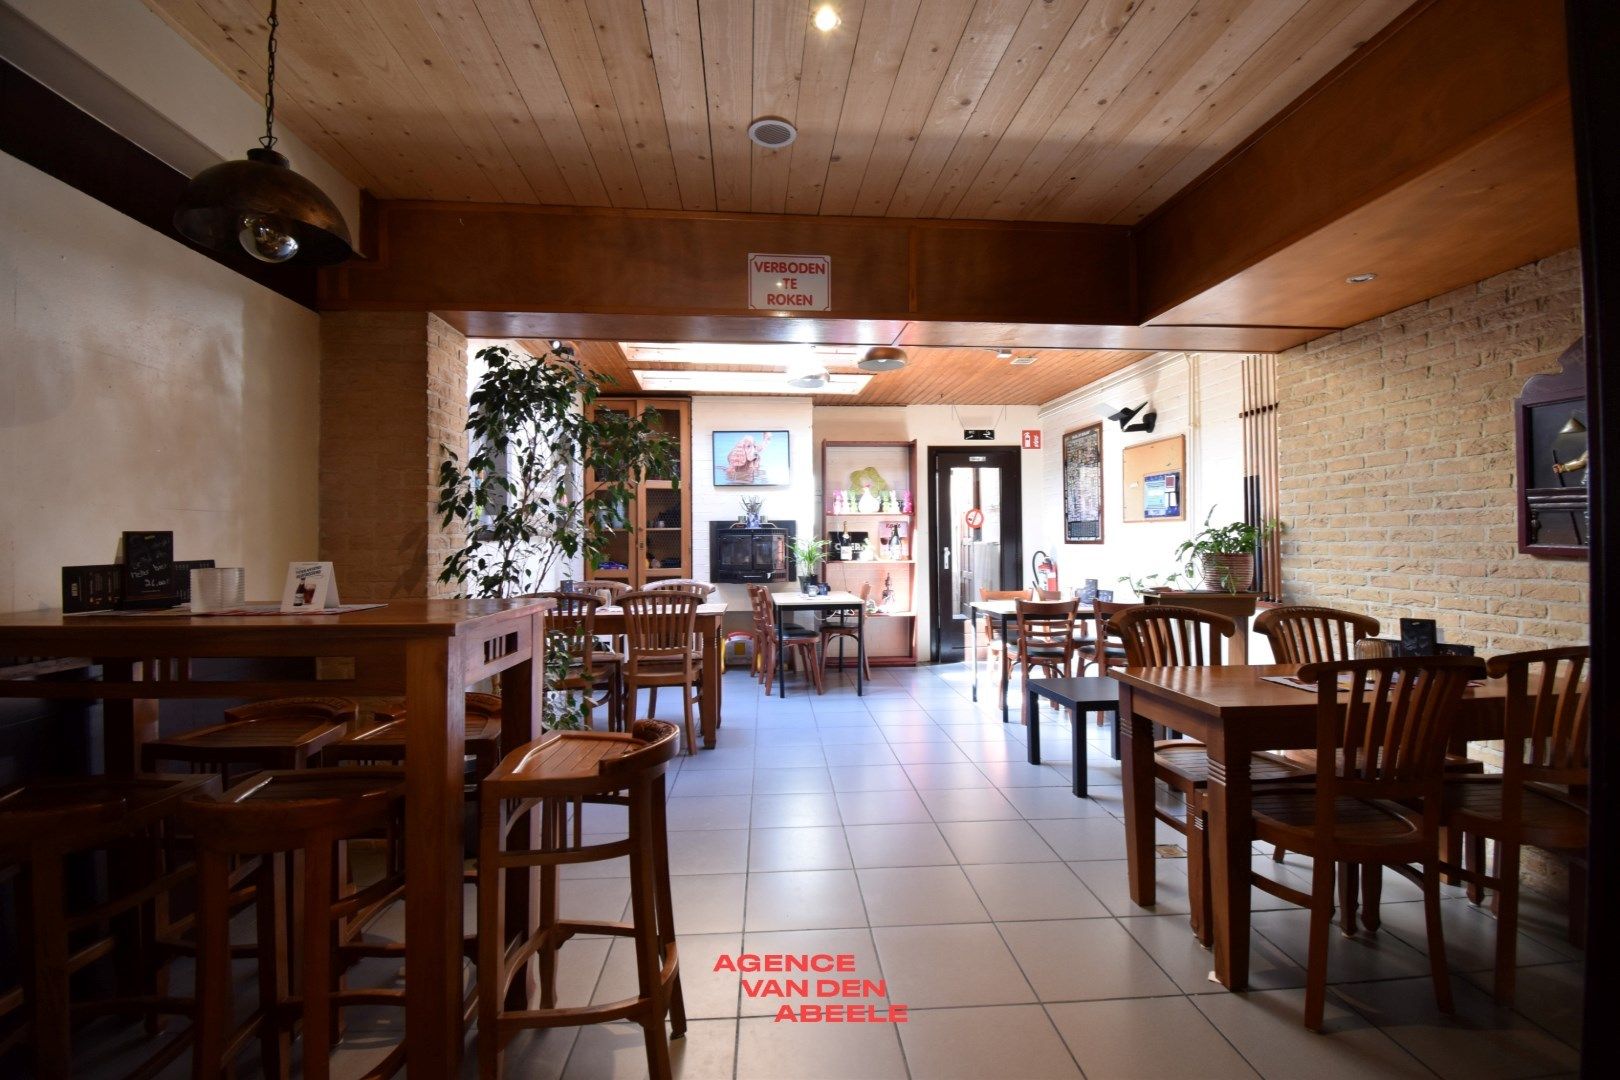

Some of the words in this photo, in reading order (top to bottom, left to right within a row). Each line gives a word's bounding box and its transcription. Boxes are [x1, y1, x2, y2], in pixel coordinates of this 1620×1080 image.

[754, 261, 825, 274] VERBODEN
[782, 278, 798, 289] TE
[767, 293, 813, 306] ROKEN
